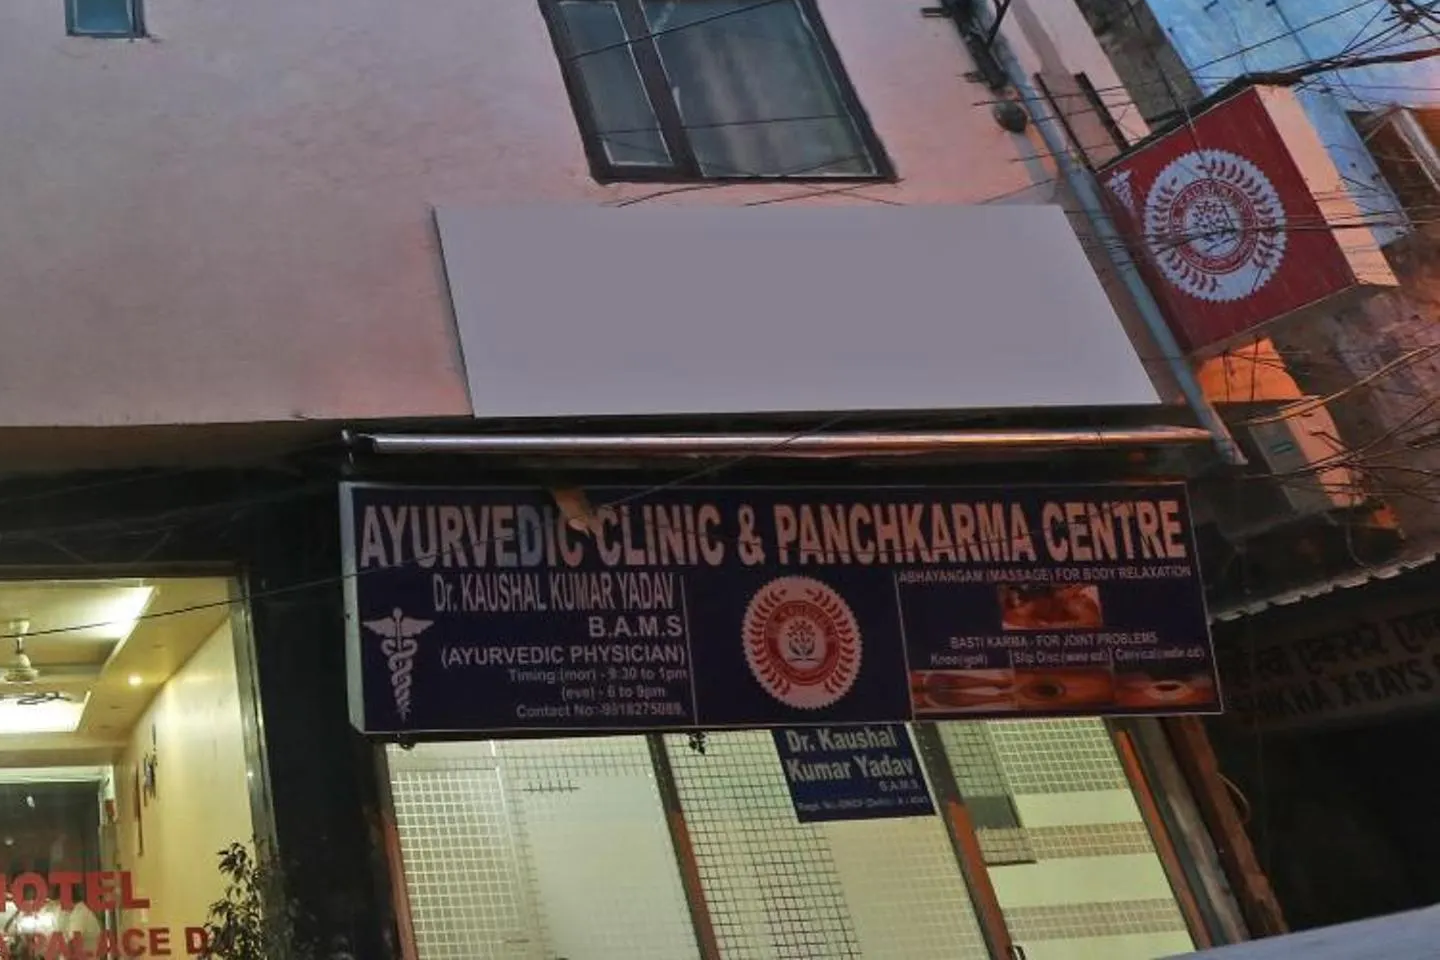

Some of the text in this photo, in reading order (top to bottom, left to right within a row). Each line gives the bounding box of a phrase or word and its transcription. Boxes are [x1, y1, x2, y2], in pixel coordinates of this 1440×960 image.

[360, 499, 1187, 569] AYURVEDIC CLINIC & PANCHKARMA CENTRE
[1055, 567, 1081, 581] FOR
[1082, 567, 1117, 580] BODY
[432, 574, 675, 612] Dr. KAUSHAL KUMAR YADAV
[588, 615, 682, 639] B.A.M.S
[440, 644, 686, 669] (AYURVEDIC PHYSICIAN)
[516, 704, 572, 720] Contact
[787, 726, 897, 752] Dr. Kaushal
[787, 752, 915, 782] Kumar Yadav
[28, 926, 173, 960] PALACE
